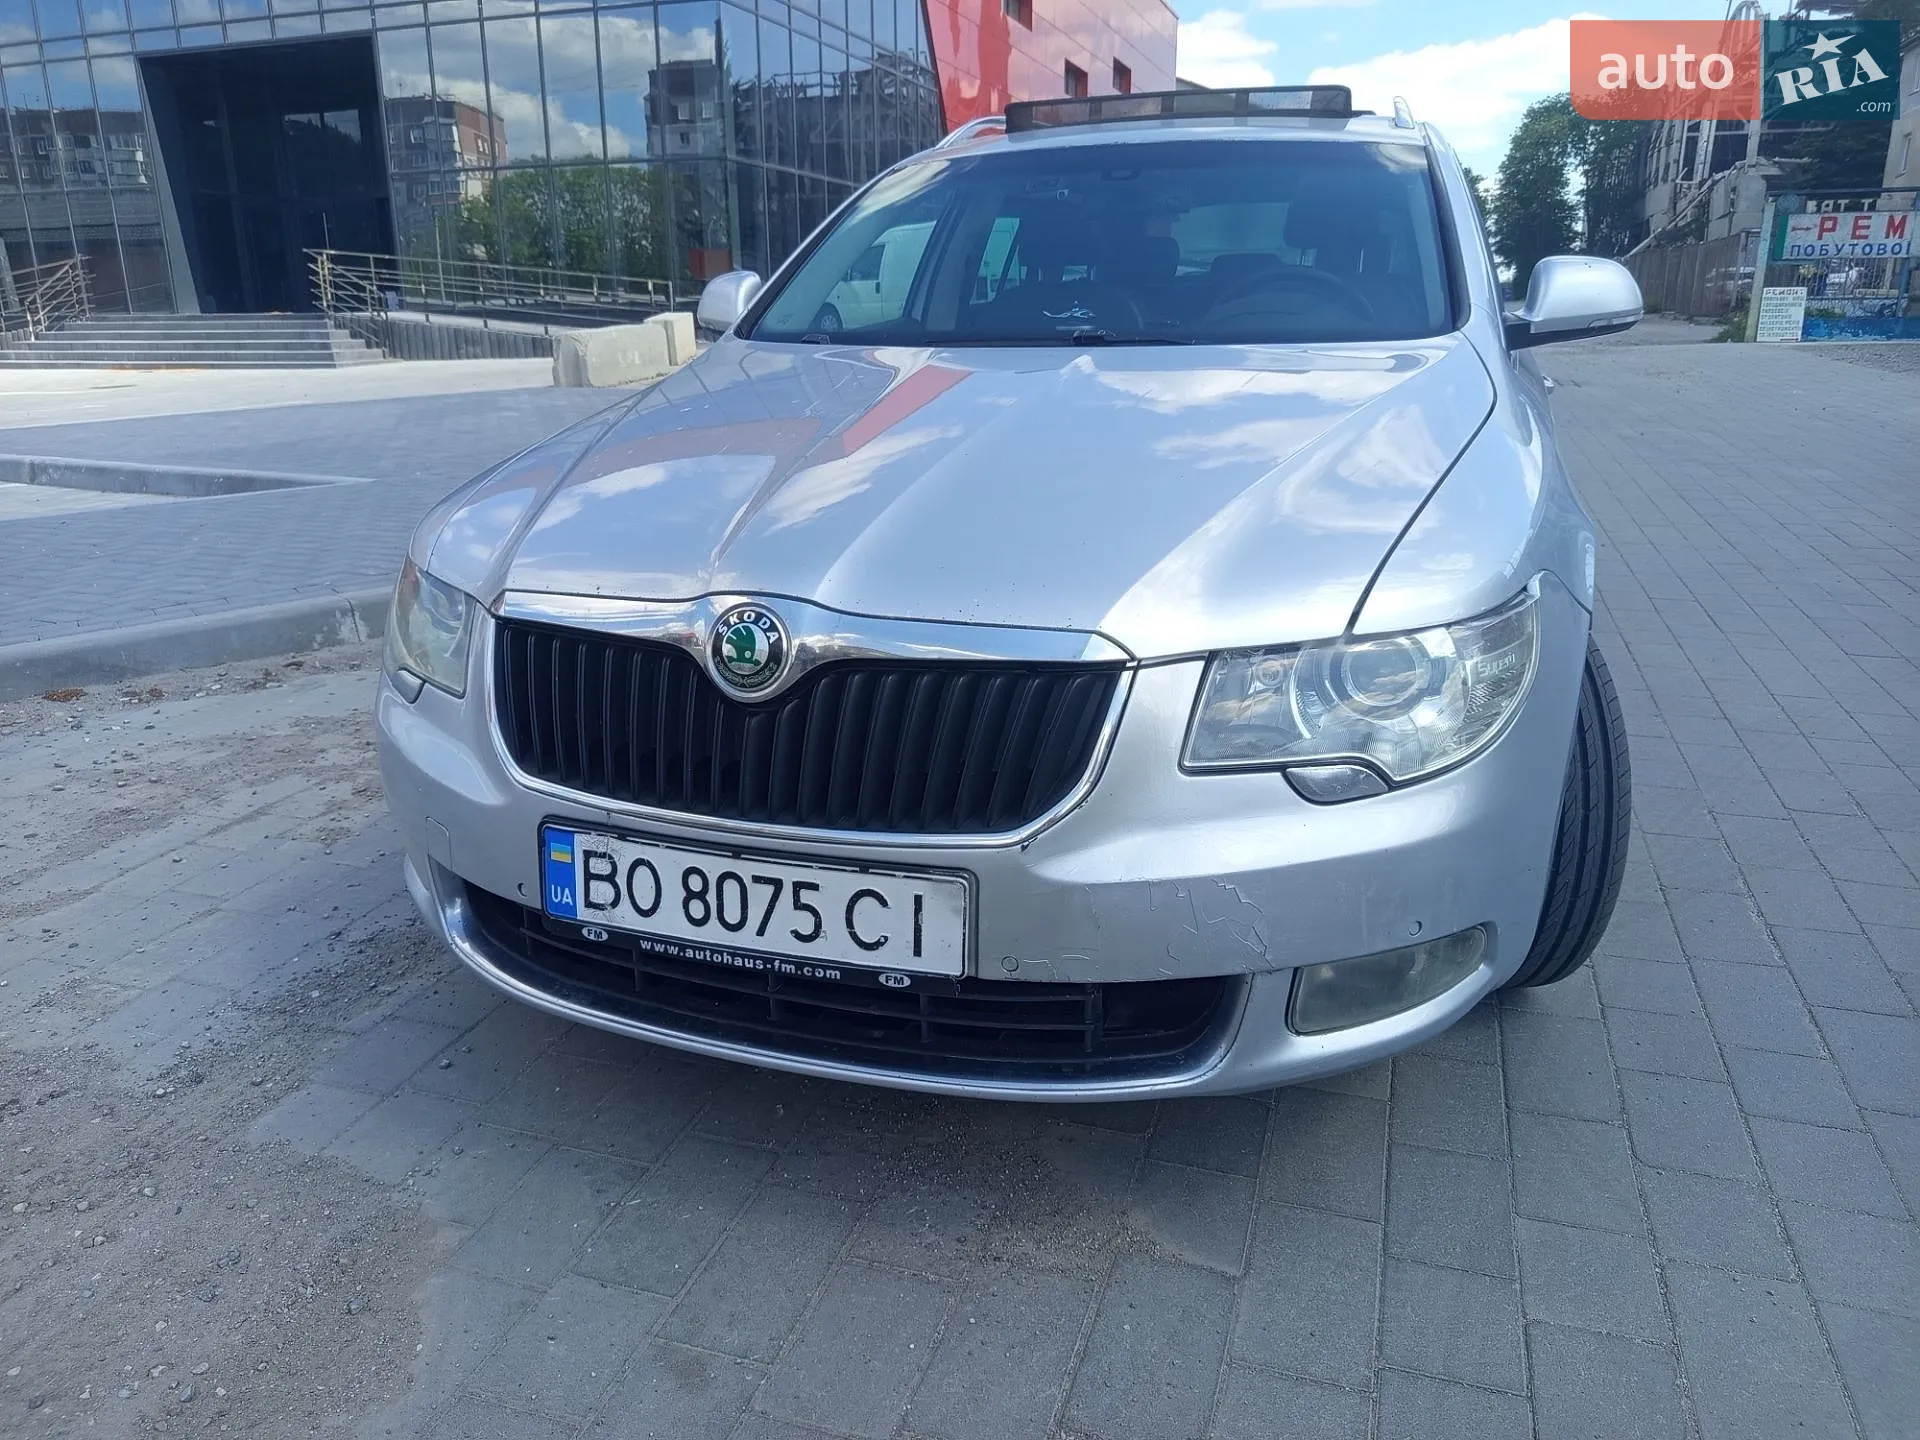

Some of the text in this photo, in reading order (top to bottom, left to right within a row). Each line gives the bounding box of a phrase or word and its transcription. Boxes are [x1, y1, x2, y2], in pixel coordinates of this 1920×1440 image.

[551, 884, 573, 906] UA
[582, 850, 923, 957] BO 8075 CI
[587, 928, 603, 940] FM
[639, 939, 841, 981] www.autohaus-fm.com
[885, 974, 905, 986] FM
